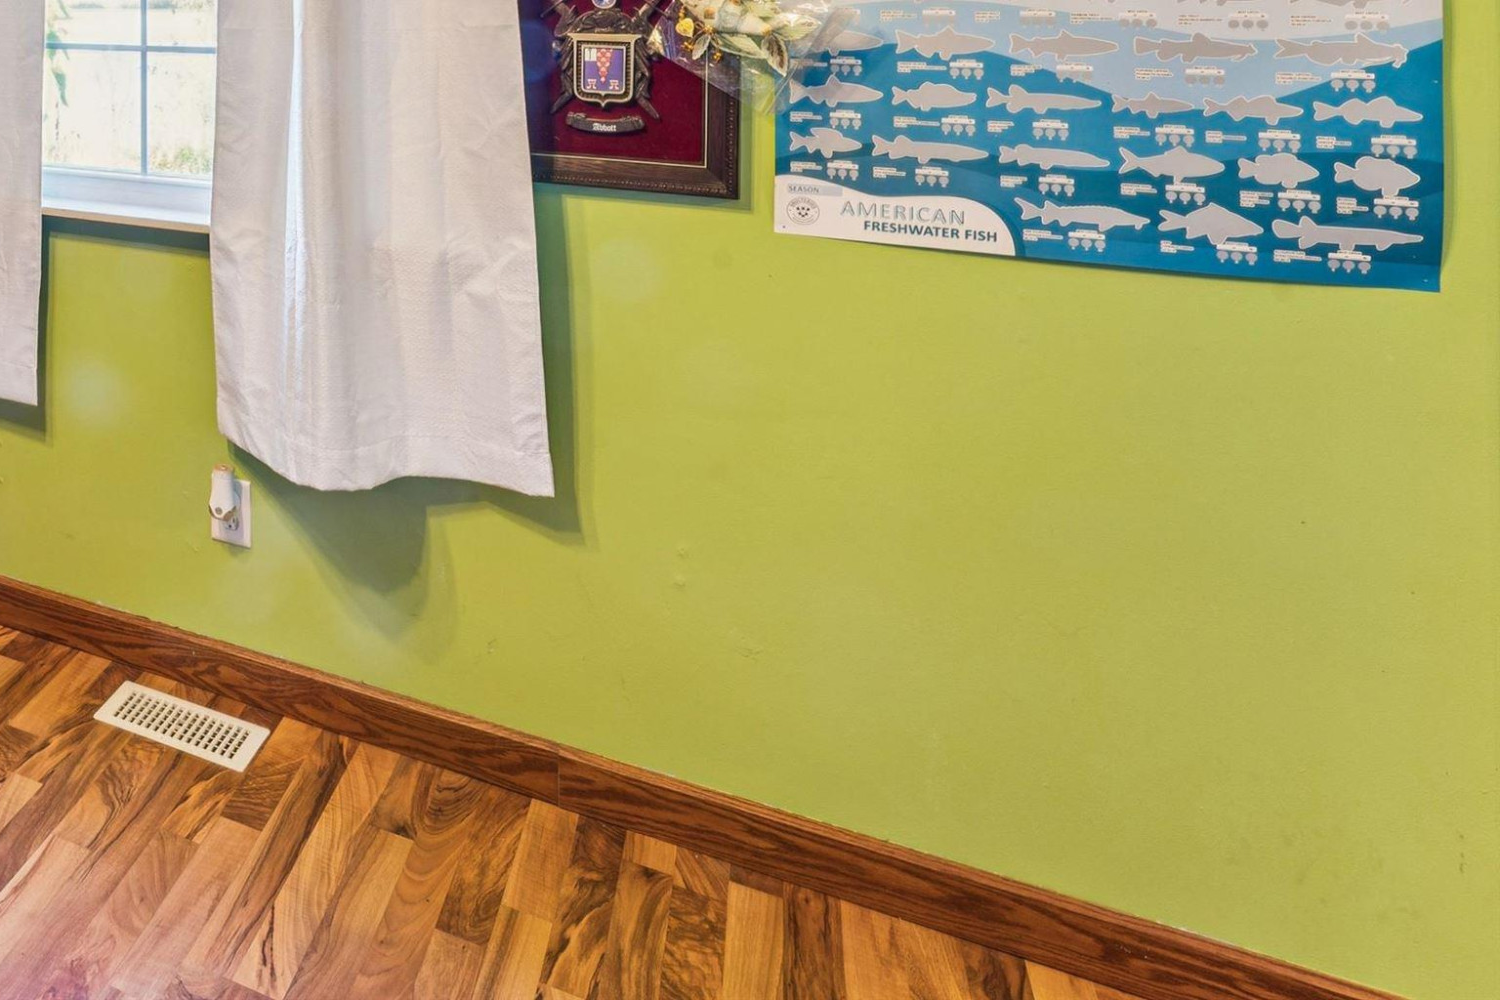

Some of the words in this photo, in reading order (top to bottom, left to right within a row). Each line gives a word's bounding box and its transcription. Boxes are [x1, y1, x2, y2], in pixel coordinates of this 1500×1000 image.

[592, 122, 617, 132] Abbott
[840, 200, 966, 226] AMERICAN
[863, 220, 960, 240] FRESHWATER
[965, 229, 998, 243] FISH
